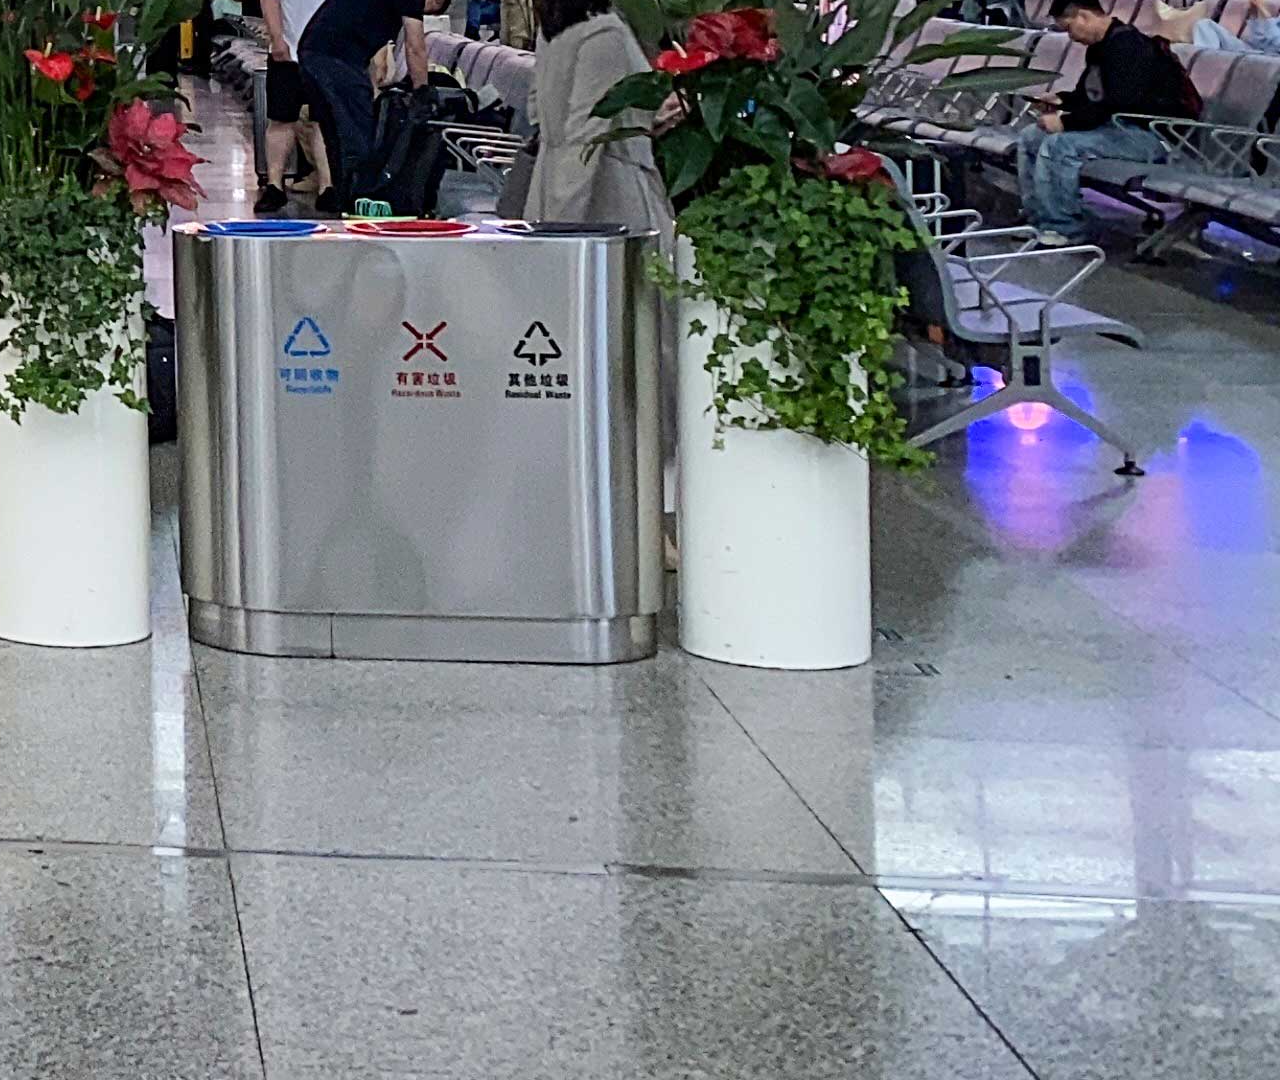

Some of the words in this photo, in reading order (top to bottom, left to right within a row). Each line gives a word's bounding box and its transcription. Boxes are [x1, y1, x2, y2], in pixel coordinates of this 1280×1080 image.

[396, 371, 457, 386] 有害垃圾
[508, 373, 569, 387] 其他垃圾
